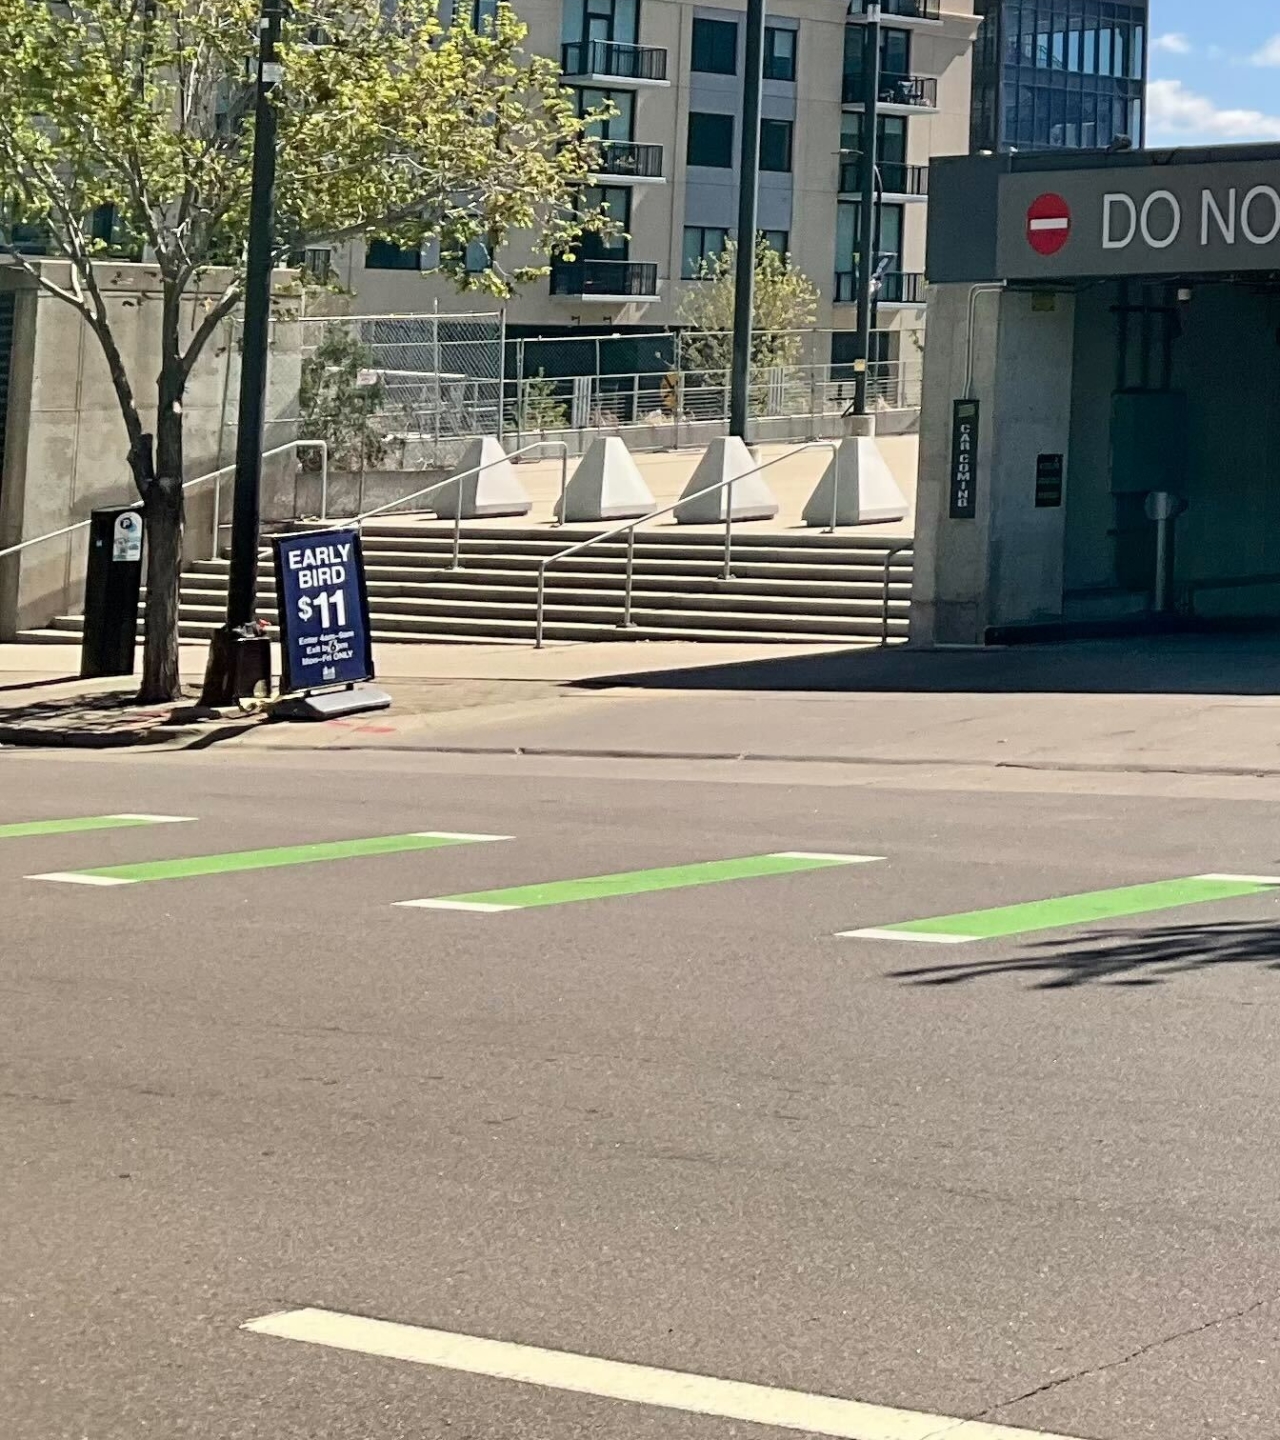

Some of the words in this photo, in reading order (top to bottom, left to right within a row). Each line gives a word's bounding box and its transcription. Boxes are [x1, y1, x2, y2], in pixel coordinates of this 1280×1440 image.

[1102, 189, 1181, 249] DO
[960, 424, 970, 451] CAR
[288, 543, 351, 570] EARLY
[298, 565, 346, 589] BIRD
[297, 588, 346, 629] $11
[333, 650, 353, 661] ONLY
